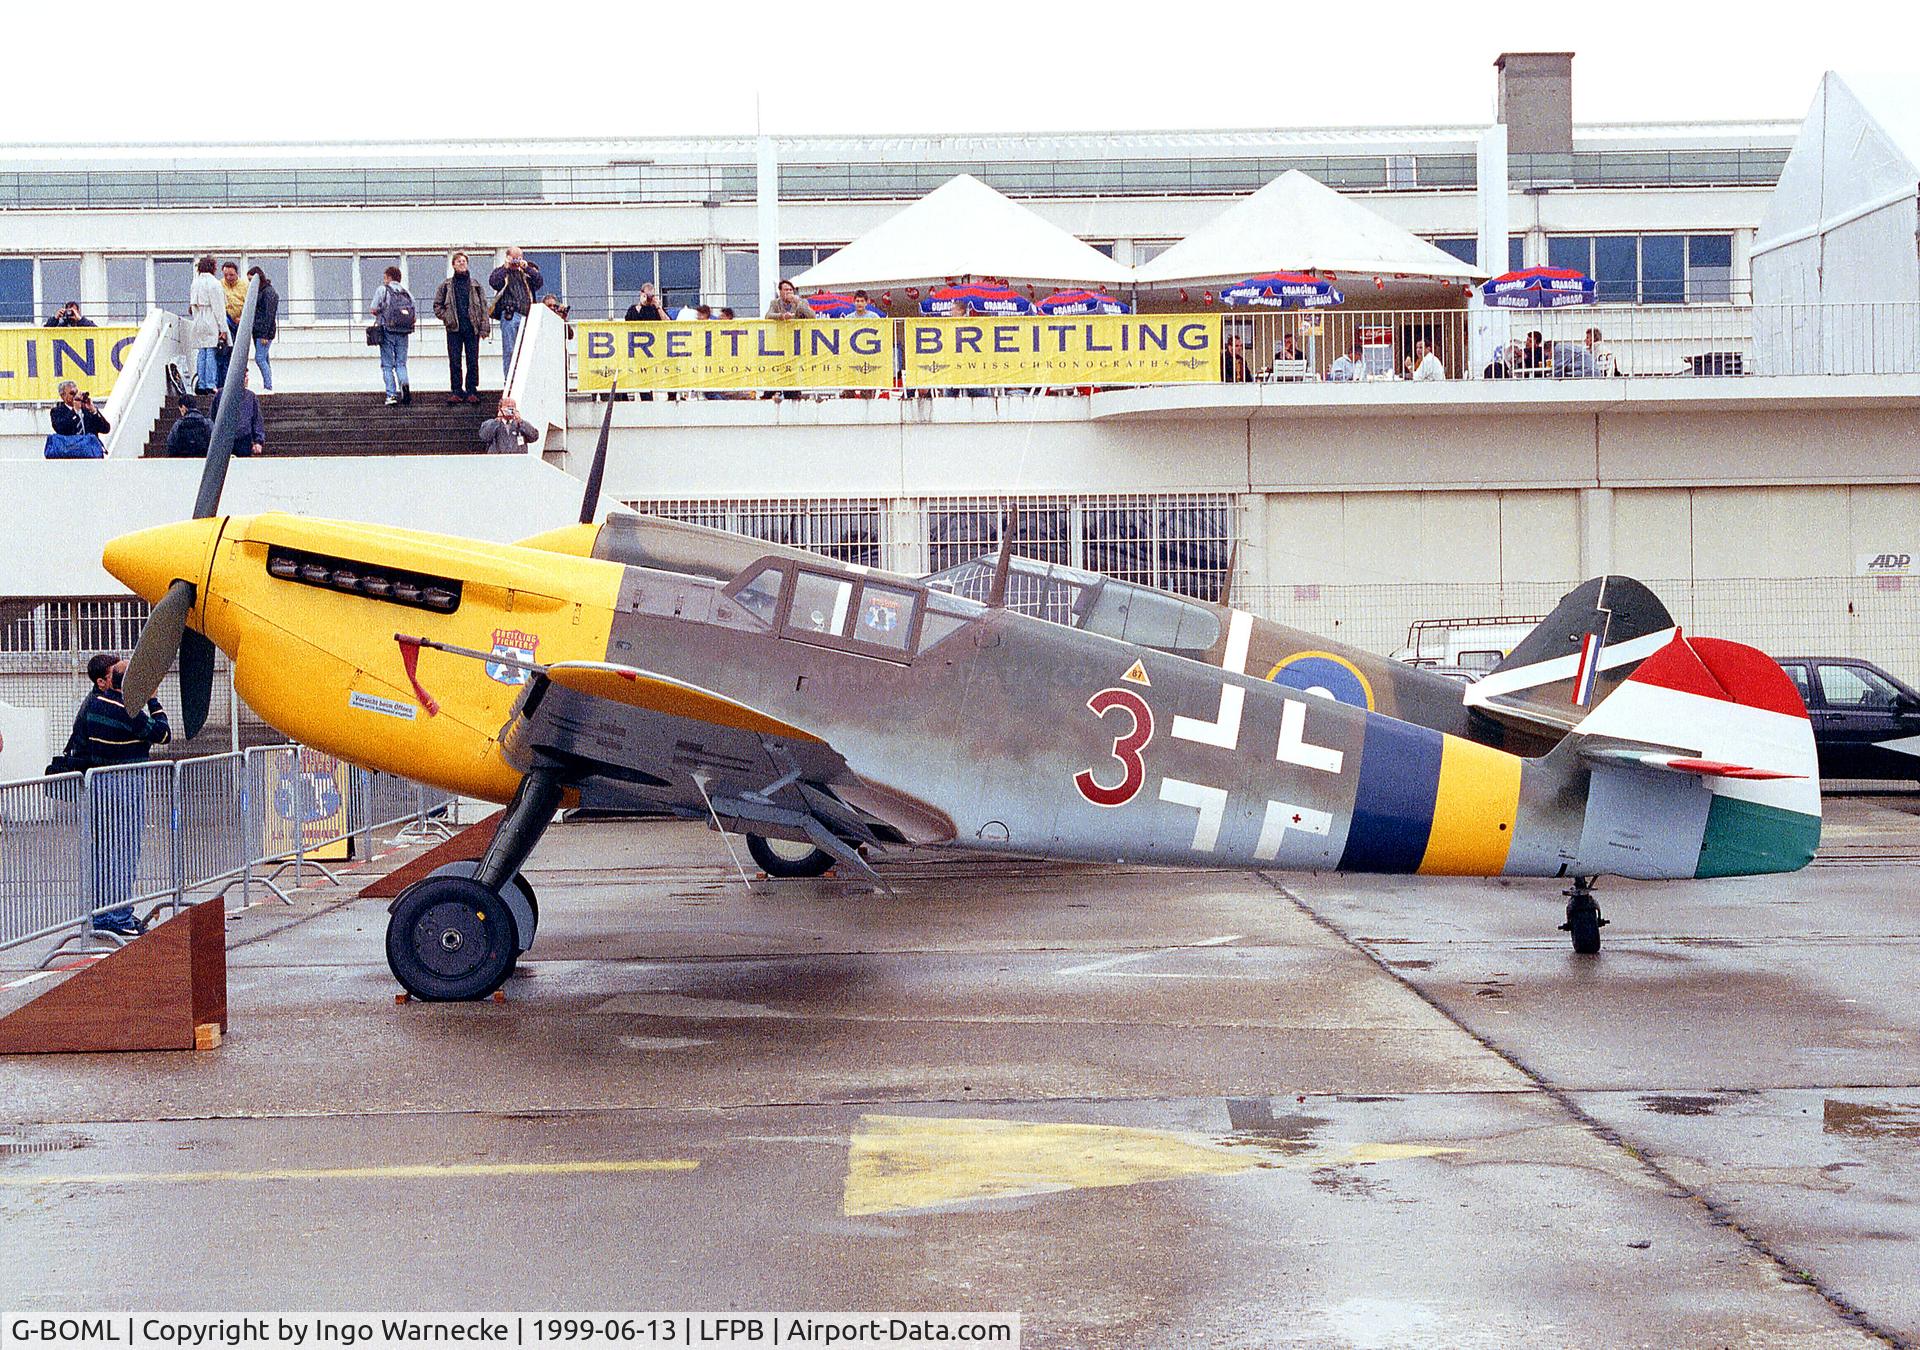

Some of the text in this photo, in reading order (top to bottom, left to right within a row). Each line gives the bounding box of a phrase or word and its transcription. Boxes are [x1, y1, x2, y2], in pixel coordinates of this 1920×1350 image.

[588, 328, 882, 359] BREITLING
[915, 323, 1209, 354] BREITLING
[628, 364, 842, 375] SWISS CHRONOGRAPHS
[955, 360, 1170, 370] SWISS CHRONOGRAPHS
[495, 629, 537, 643] BREITLING
[496, 637, 534, 650] FIGHTERS
[1072, 687, 1155, 807] 3
